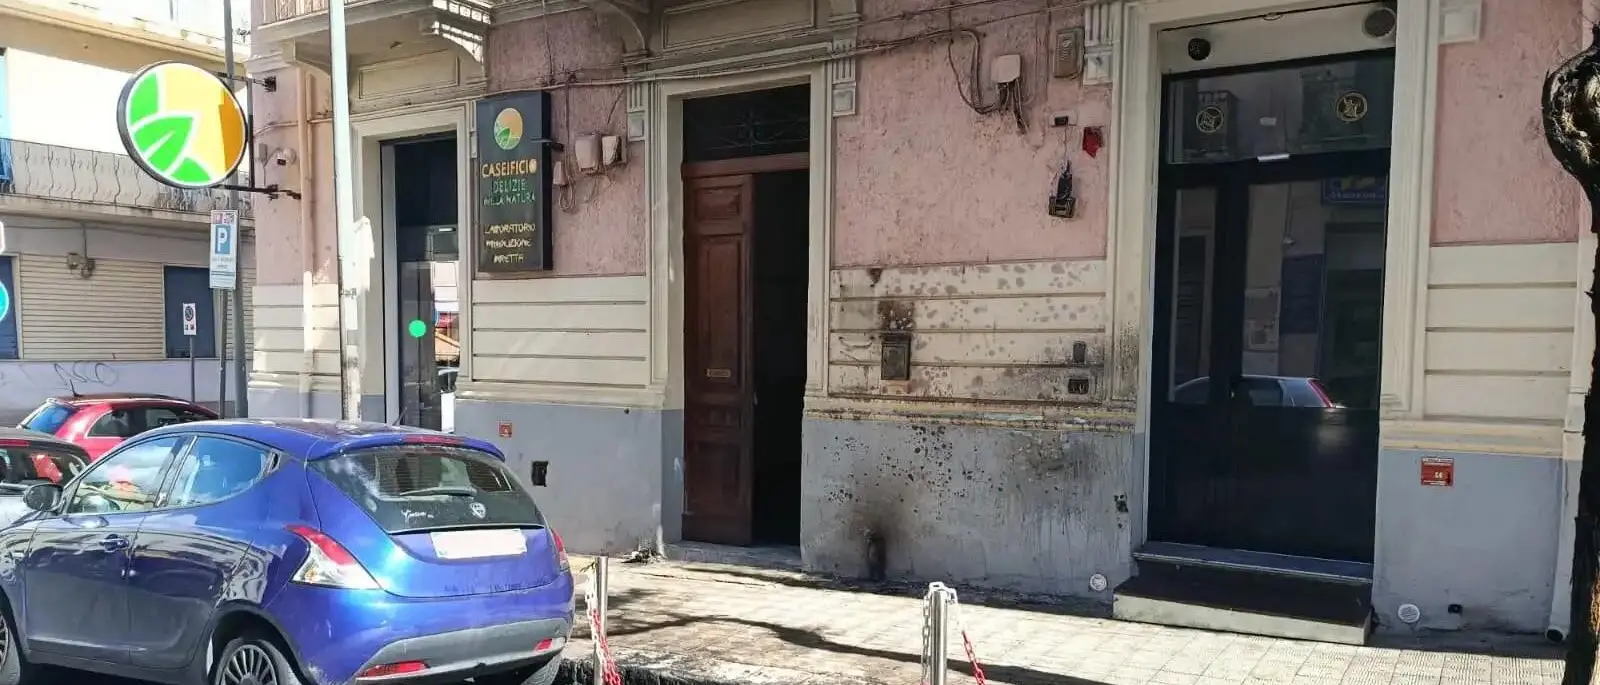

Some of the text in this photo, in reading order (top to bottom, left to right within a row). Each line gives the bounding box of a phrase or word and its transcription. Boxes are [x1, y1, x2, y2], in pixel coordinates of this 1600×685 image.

[481, 158, 537, 177] CASEIFICIO
[493, 179, 527, 193] DELIZIE
[217, 227, 228, 252] P
